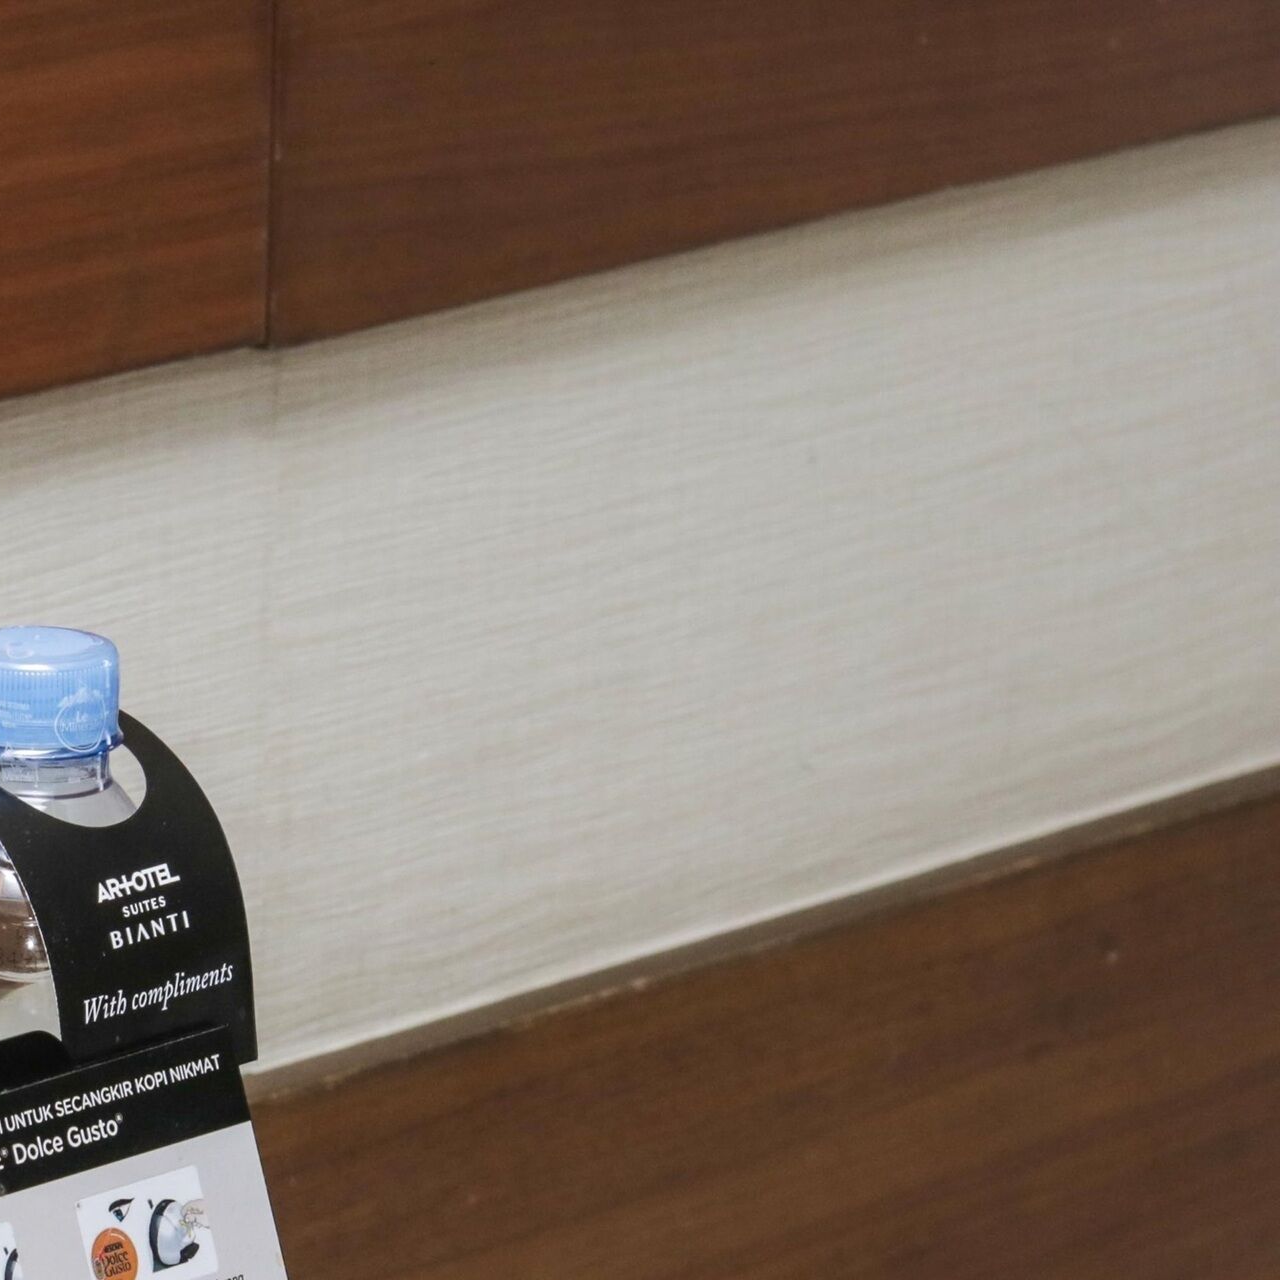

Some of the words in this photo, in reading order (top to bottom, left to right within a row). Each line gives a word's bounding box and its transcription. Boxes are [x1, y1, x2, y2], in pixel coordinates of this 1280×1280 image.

[122, 895, 167, 918] SUITES
[110, 910, 190, 950] BIANTI
[83, 988, 128, 1025] With
[131, 962, 234, 1011] compliments
[4, 1104, 54, 1137] UNTUK
[54, 1081, 134, 1118] SECANGKIR
[135, 1070, 169, 1095] KOPI
[171, 1054, 221, 1083] NIKMAT
[12, 1134, 65, 1165] Dolce
